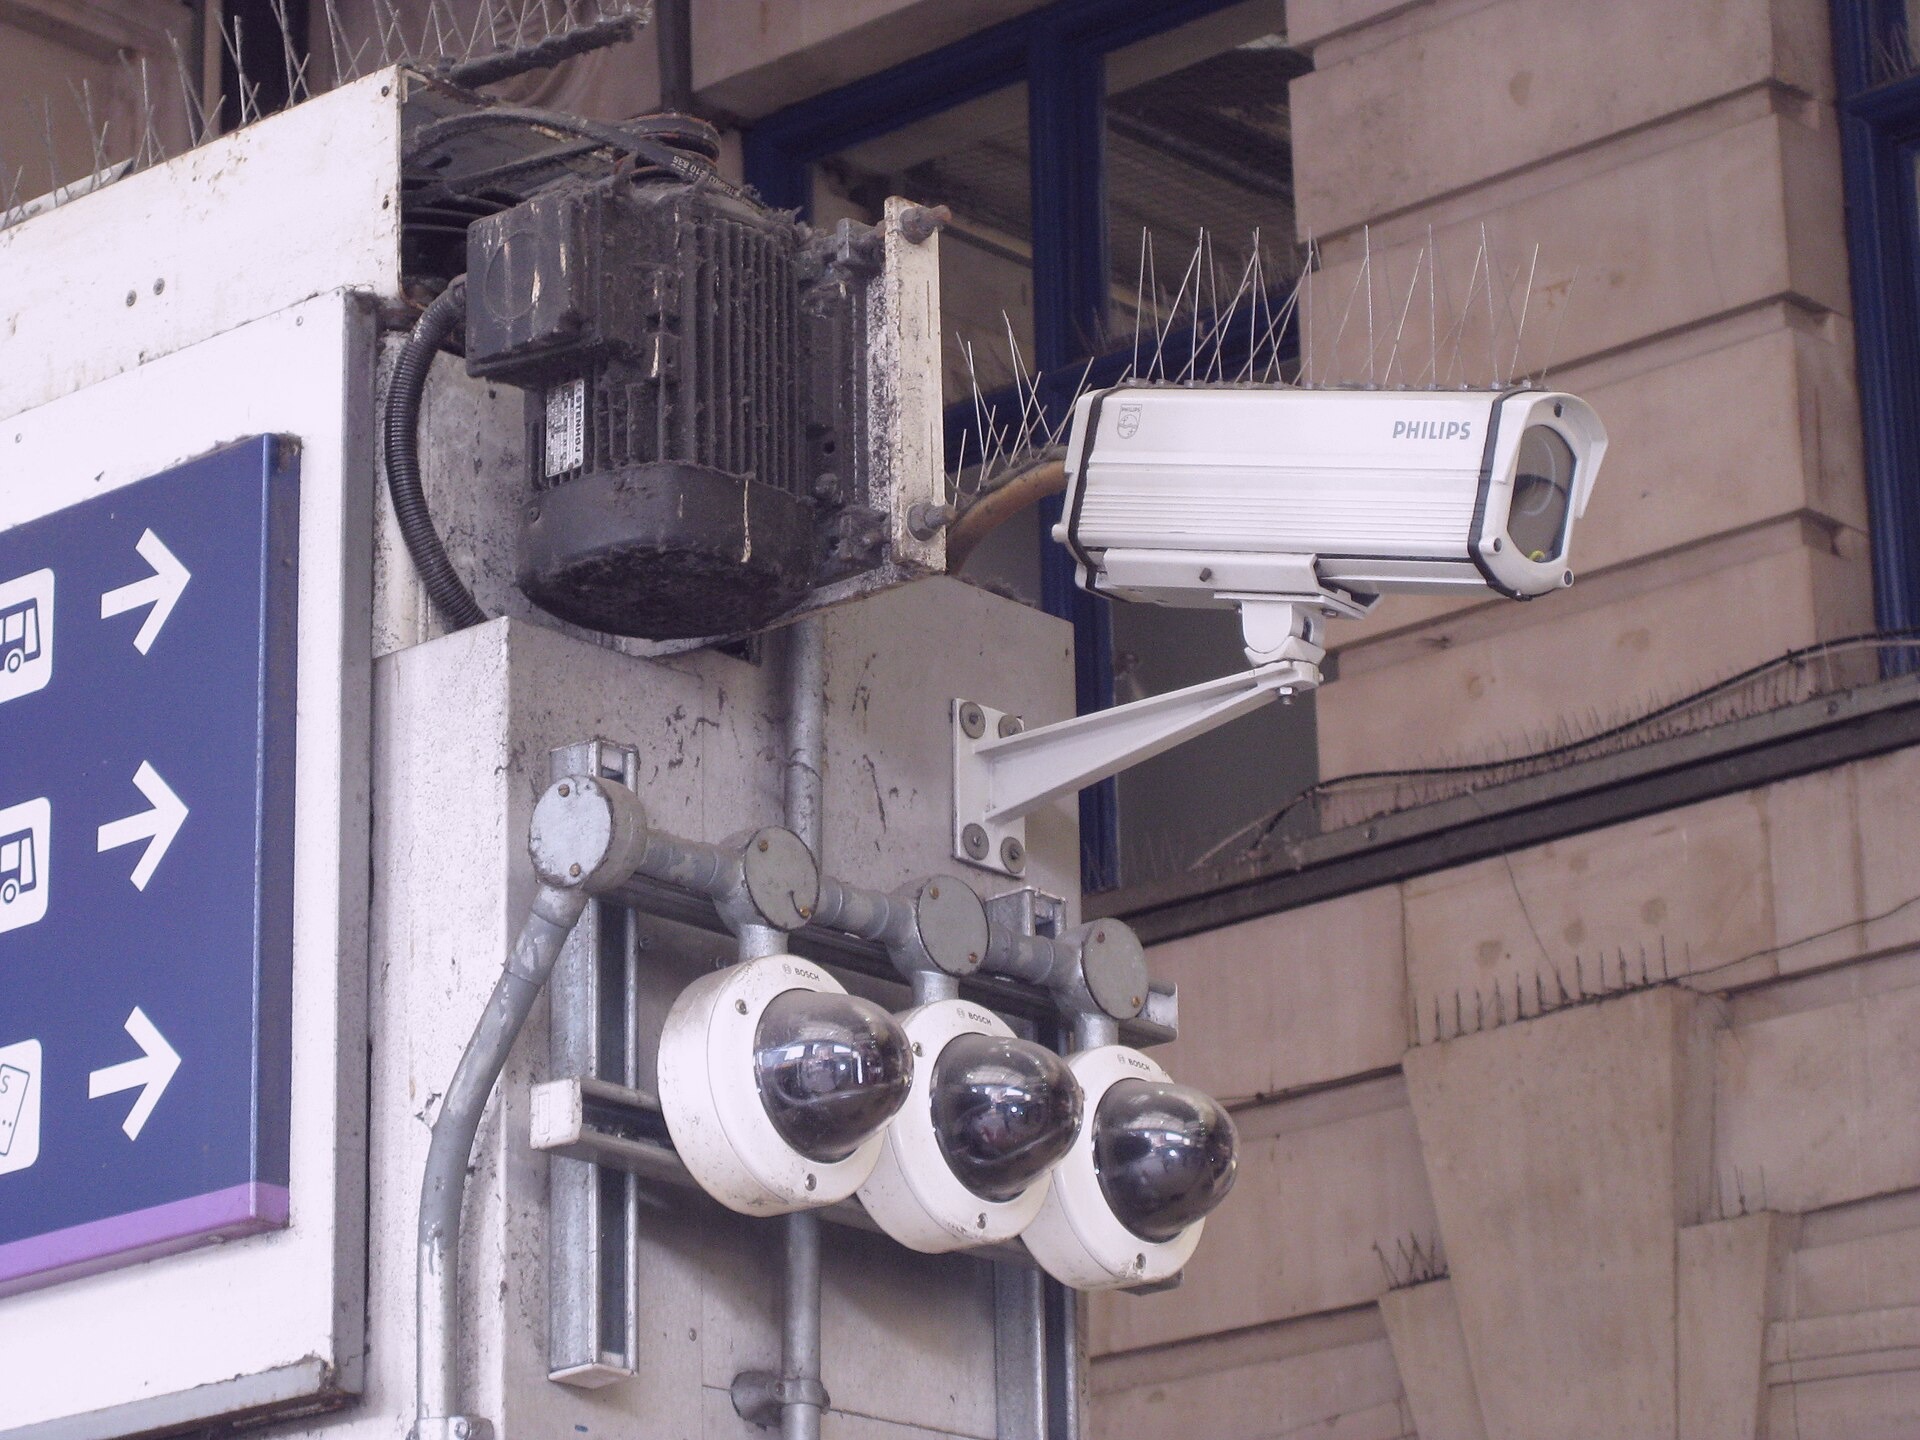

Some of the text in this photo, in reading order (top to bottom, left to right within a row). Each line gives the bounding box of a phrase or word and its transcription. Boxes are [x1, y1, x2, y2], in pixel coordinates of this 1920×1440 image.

[1392, 420, 1471, 440] PHILIPS
[794, 967, 820, 981] BOSCH
[968, 1012, 991, 1026] BOSCH
[1128, 1058, 1150, 1072] BOSCH
